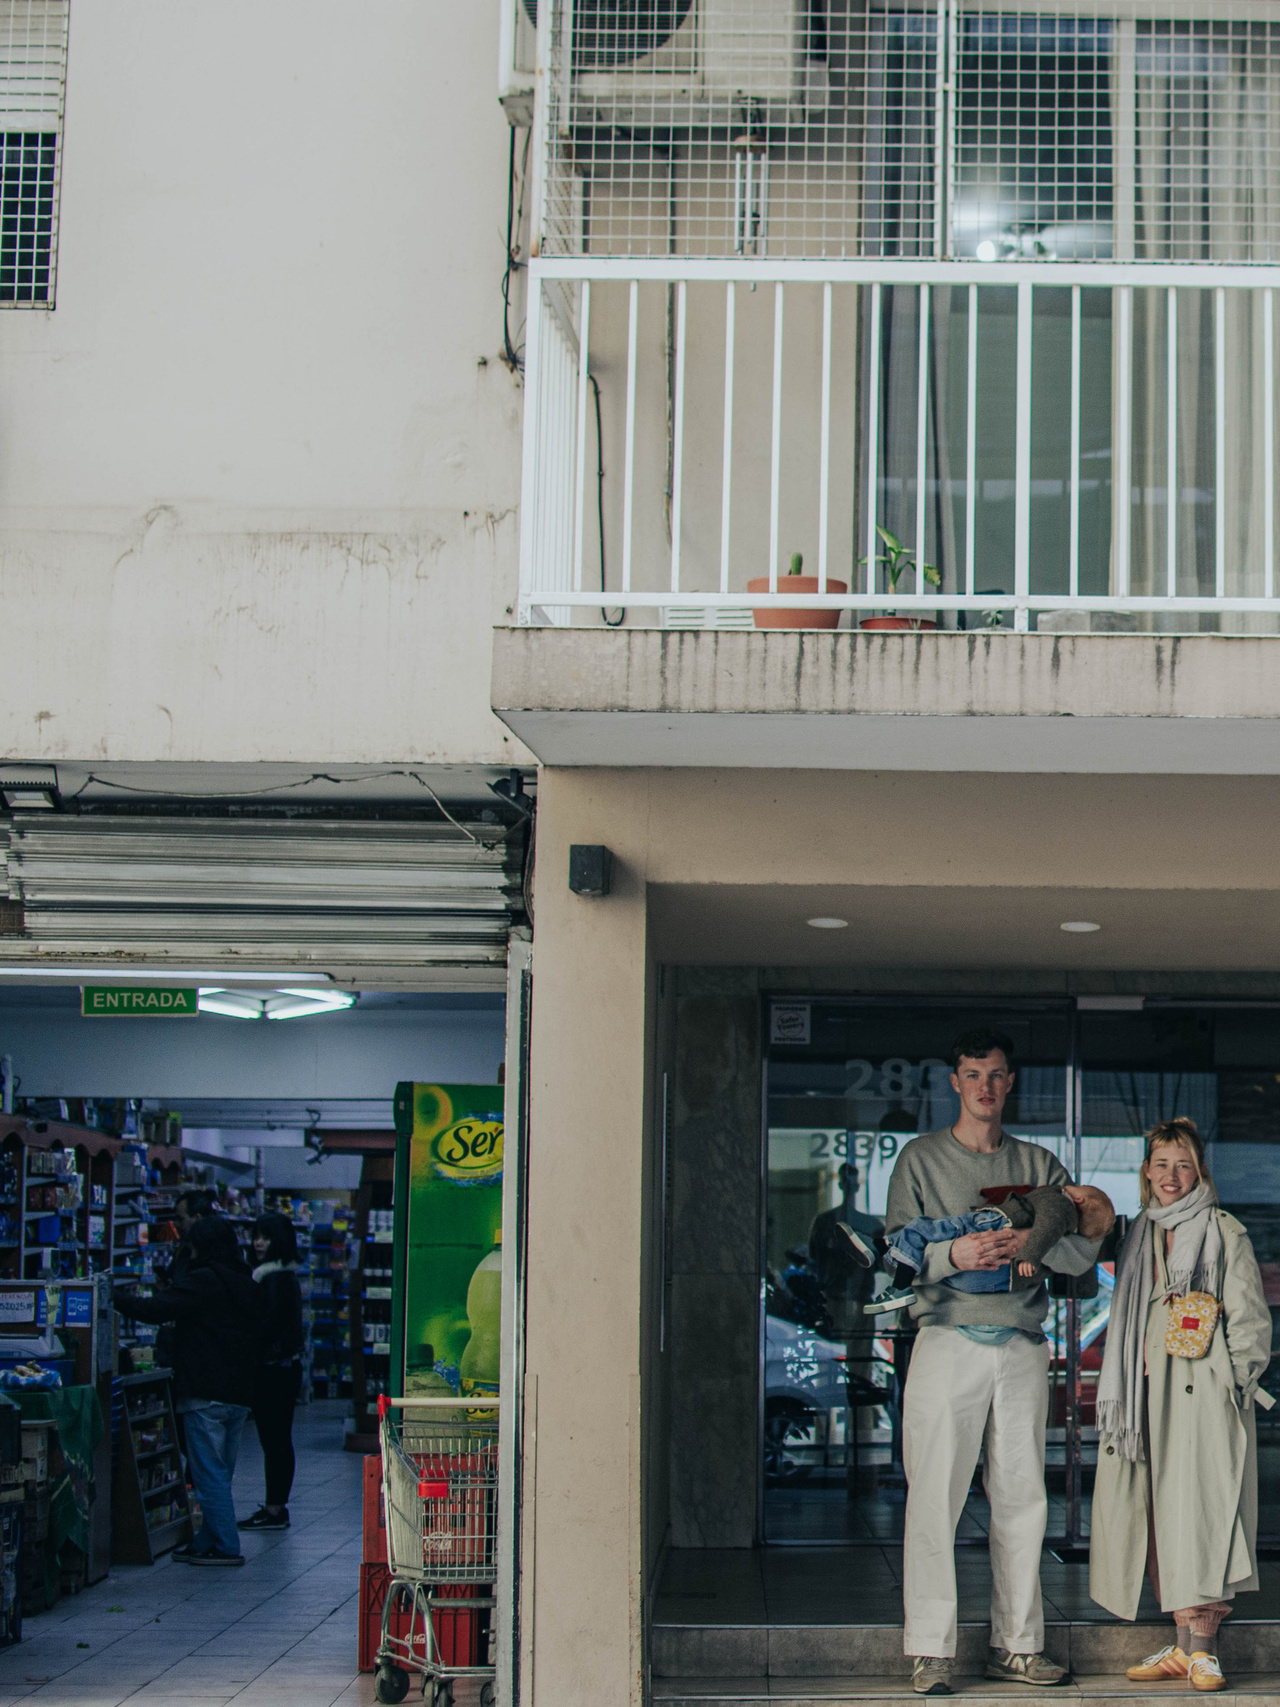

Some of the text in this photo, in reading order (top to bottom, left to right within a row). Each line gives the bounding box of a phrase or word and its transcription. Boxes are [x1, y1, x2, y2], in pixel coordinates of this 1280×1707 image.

[93, 992, 187, 1008] ENTRADA
[844, 1058, 951, 1099] 283
[810, 1132, 898, 1160] 2839
